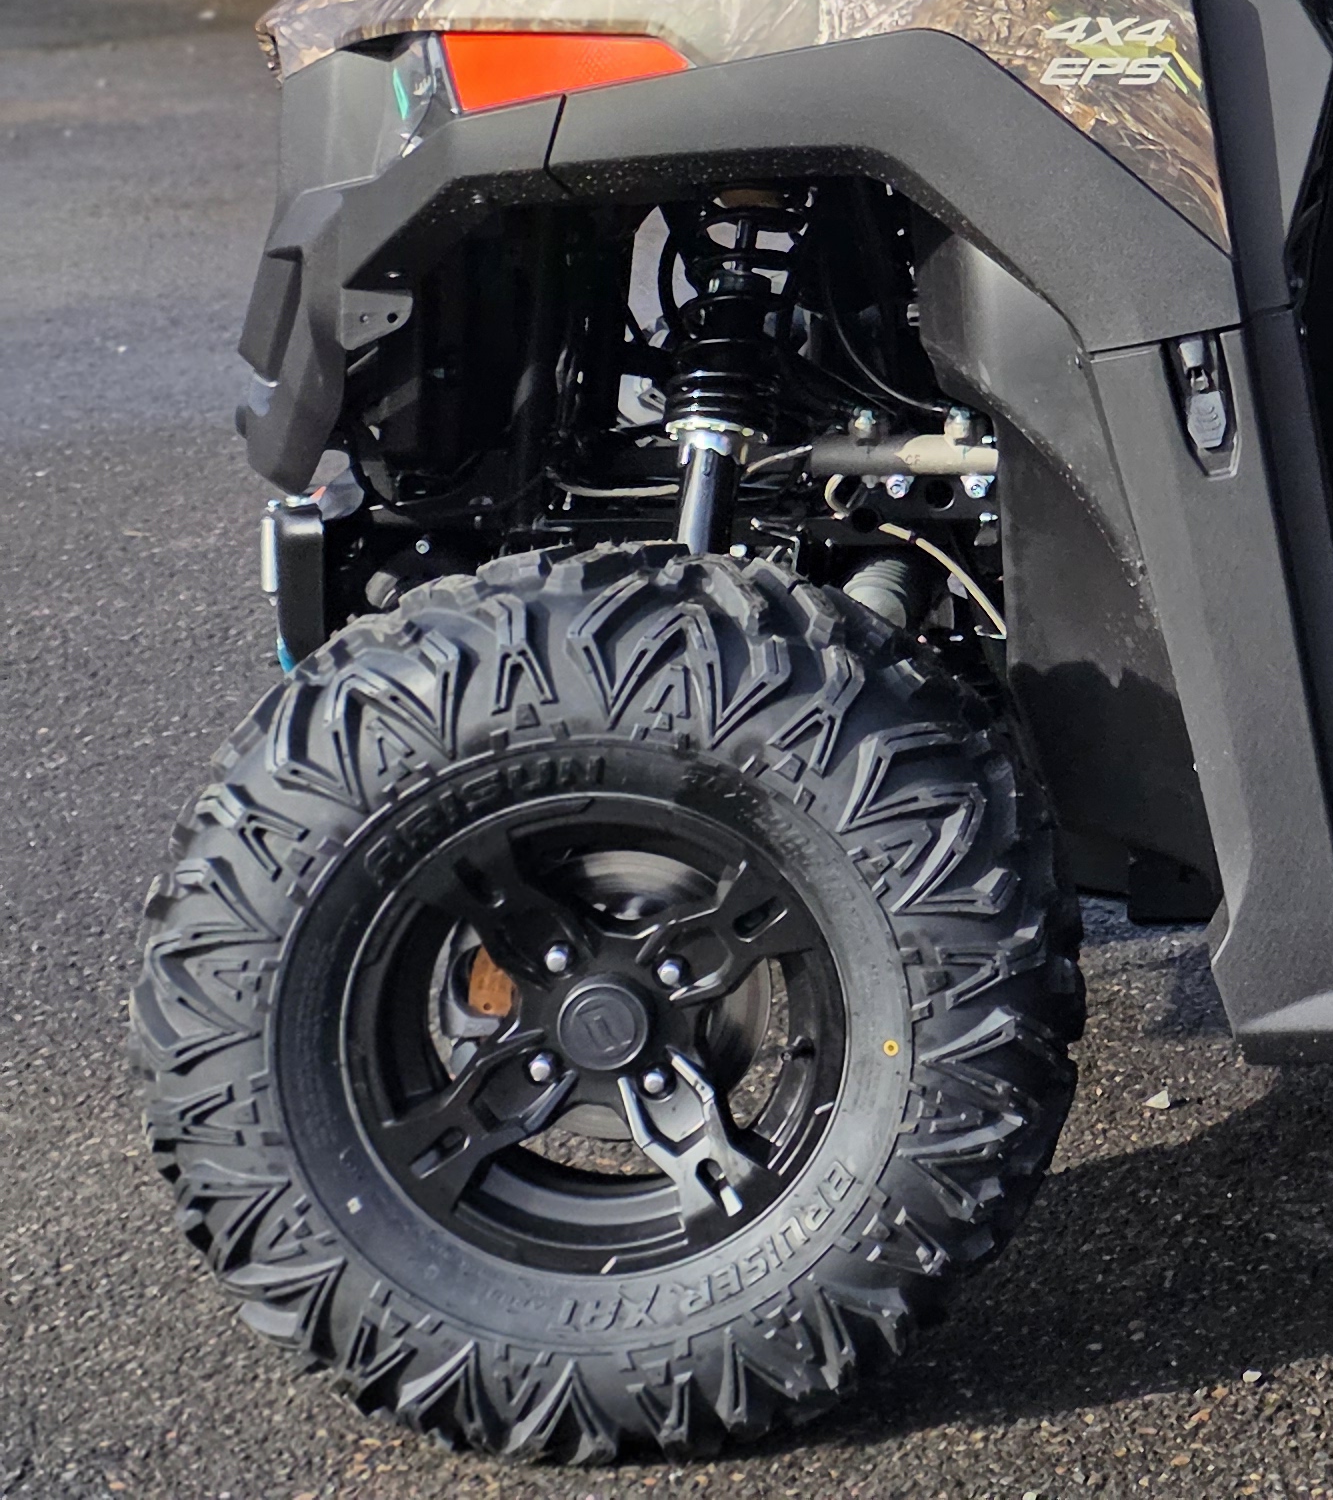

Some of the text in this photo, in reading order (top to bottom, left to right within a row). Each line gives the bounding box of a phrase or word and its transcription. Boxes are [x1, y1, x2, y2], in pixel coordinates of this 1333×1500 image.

[1045, 16, 1170, 46] 4X4
[1039, 57, 1170, 86] EPS
[674, 1160, 858, 1318] BRUISER
